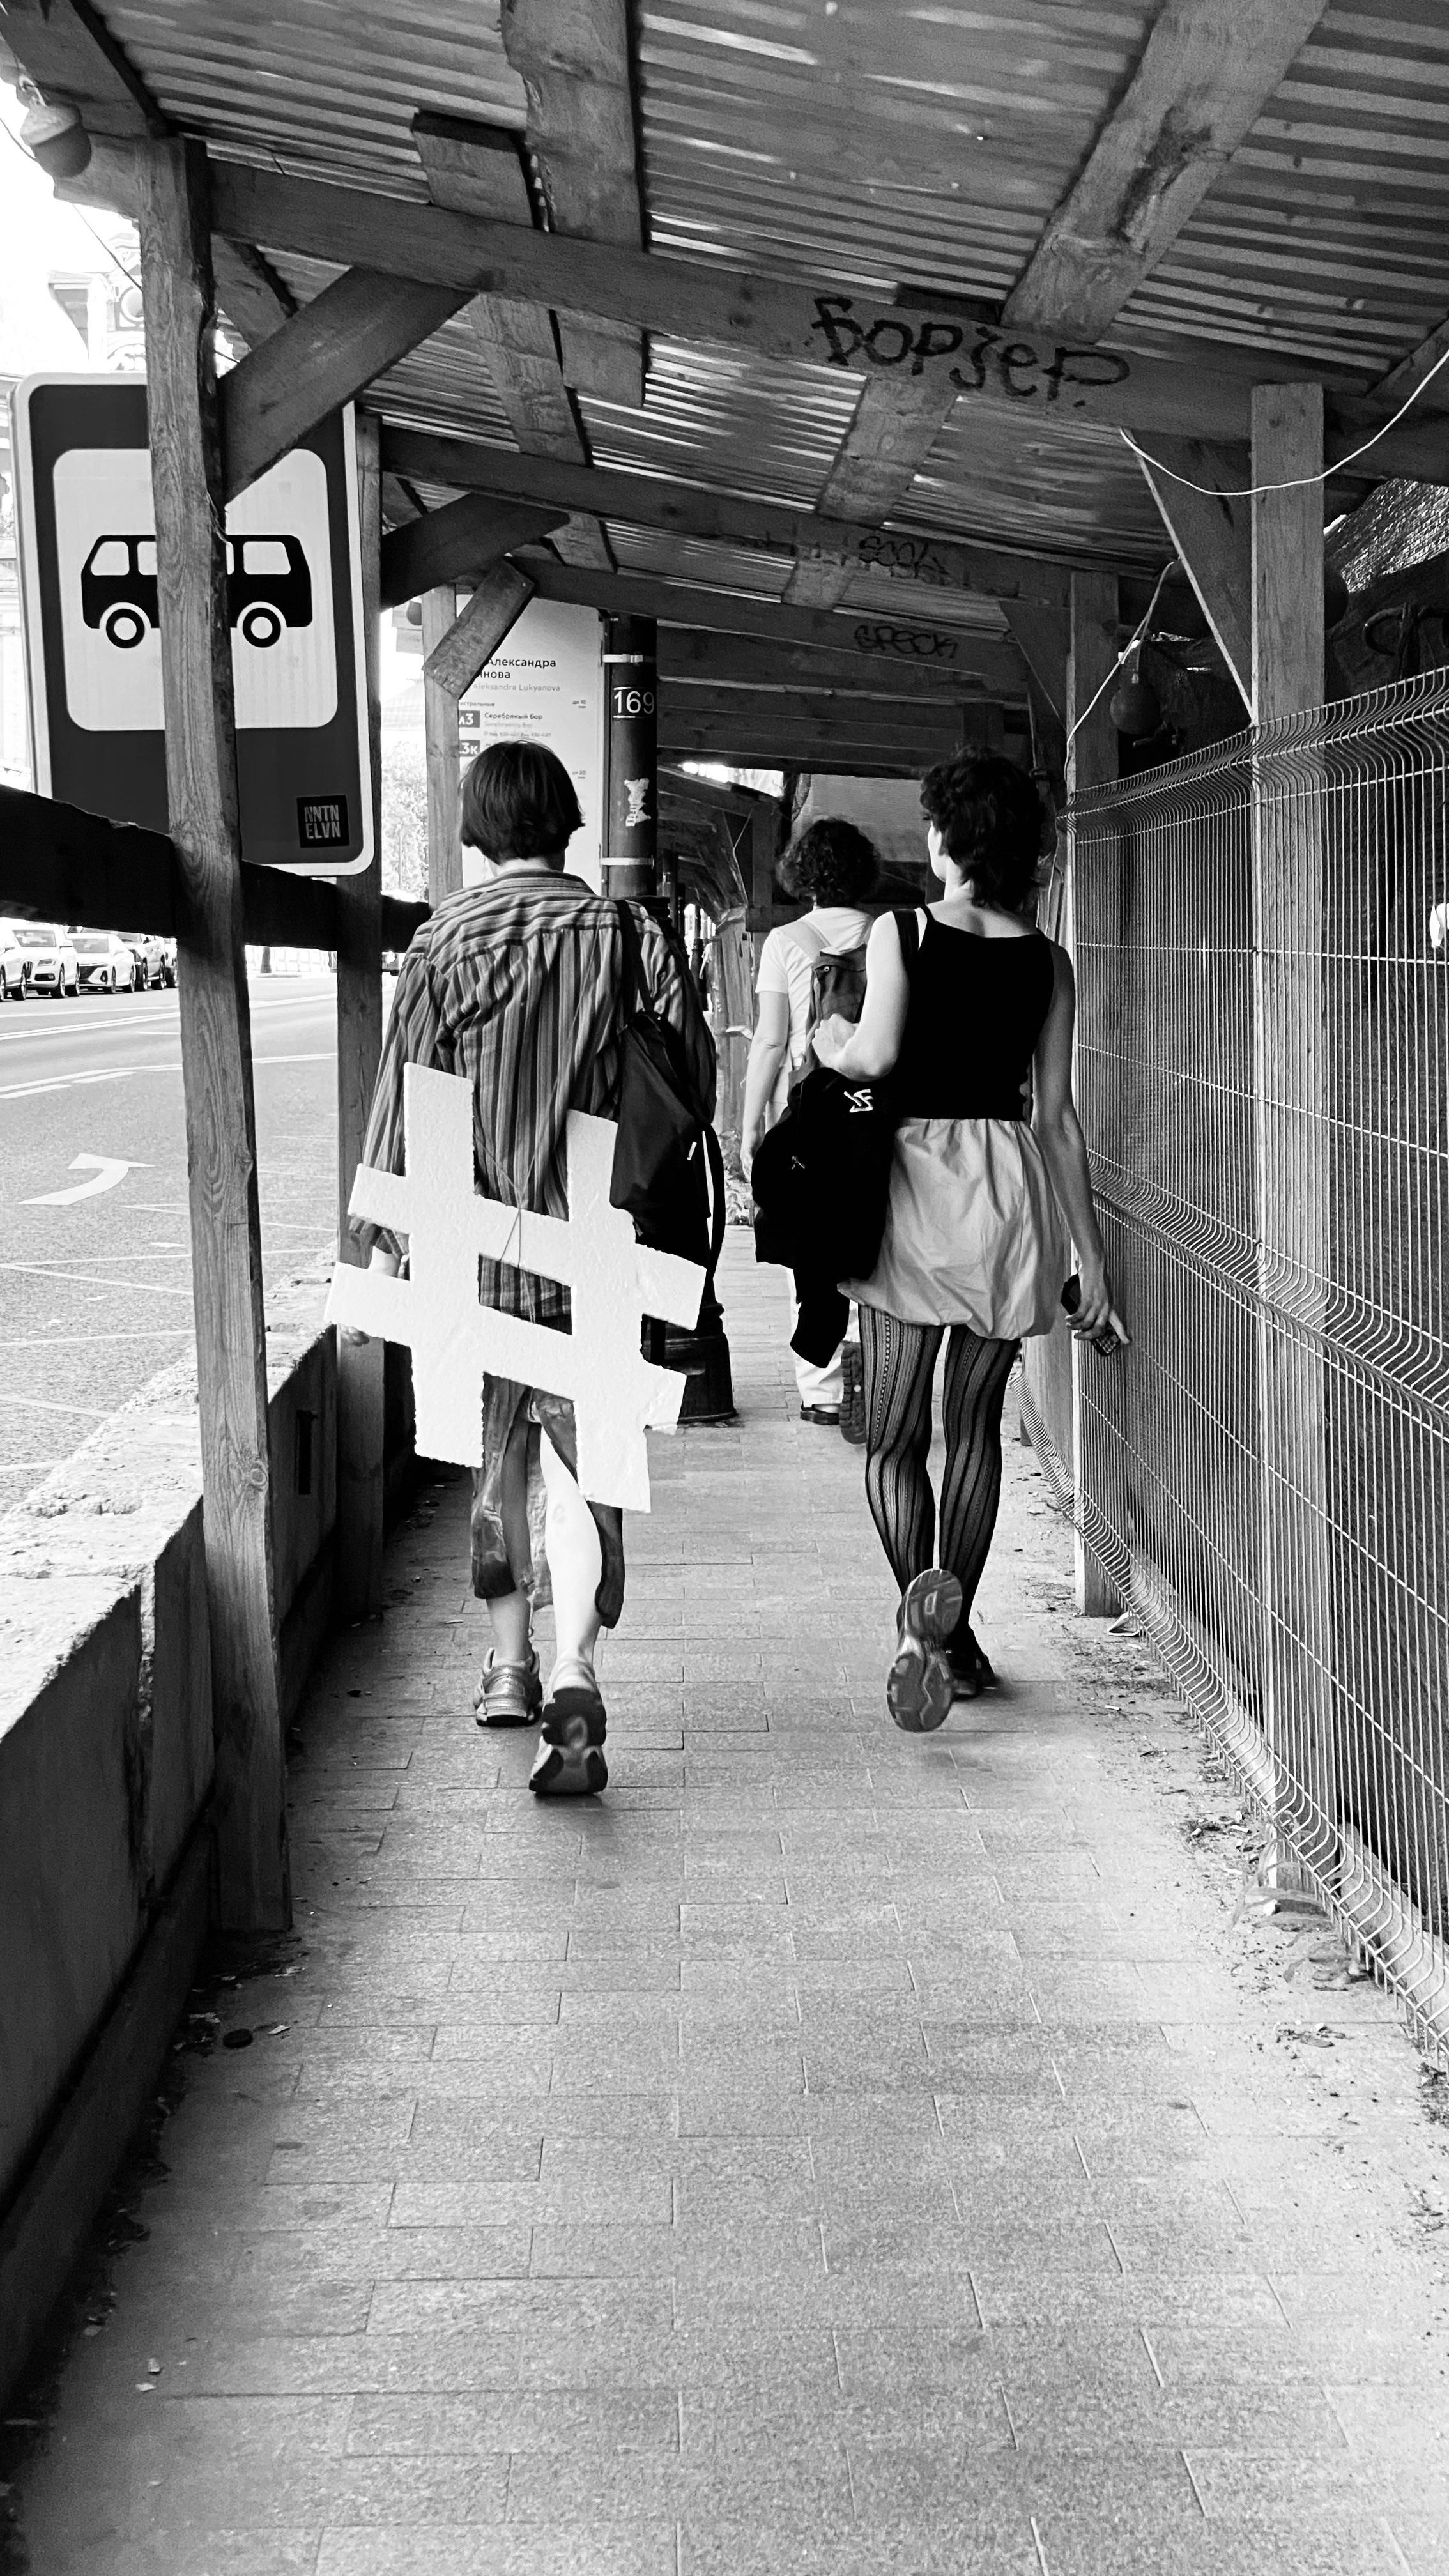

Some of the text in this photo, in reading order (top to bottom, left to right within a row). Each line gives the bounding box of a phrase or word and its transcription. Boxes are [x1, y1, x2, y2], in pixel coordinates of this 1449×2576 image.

[487, 659, 556, 669] Александра
[519, 684, 560, 693] Lukyanova
[614, 690, 655, 714] 169
[306, 821, 341, 839] ELVN
